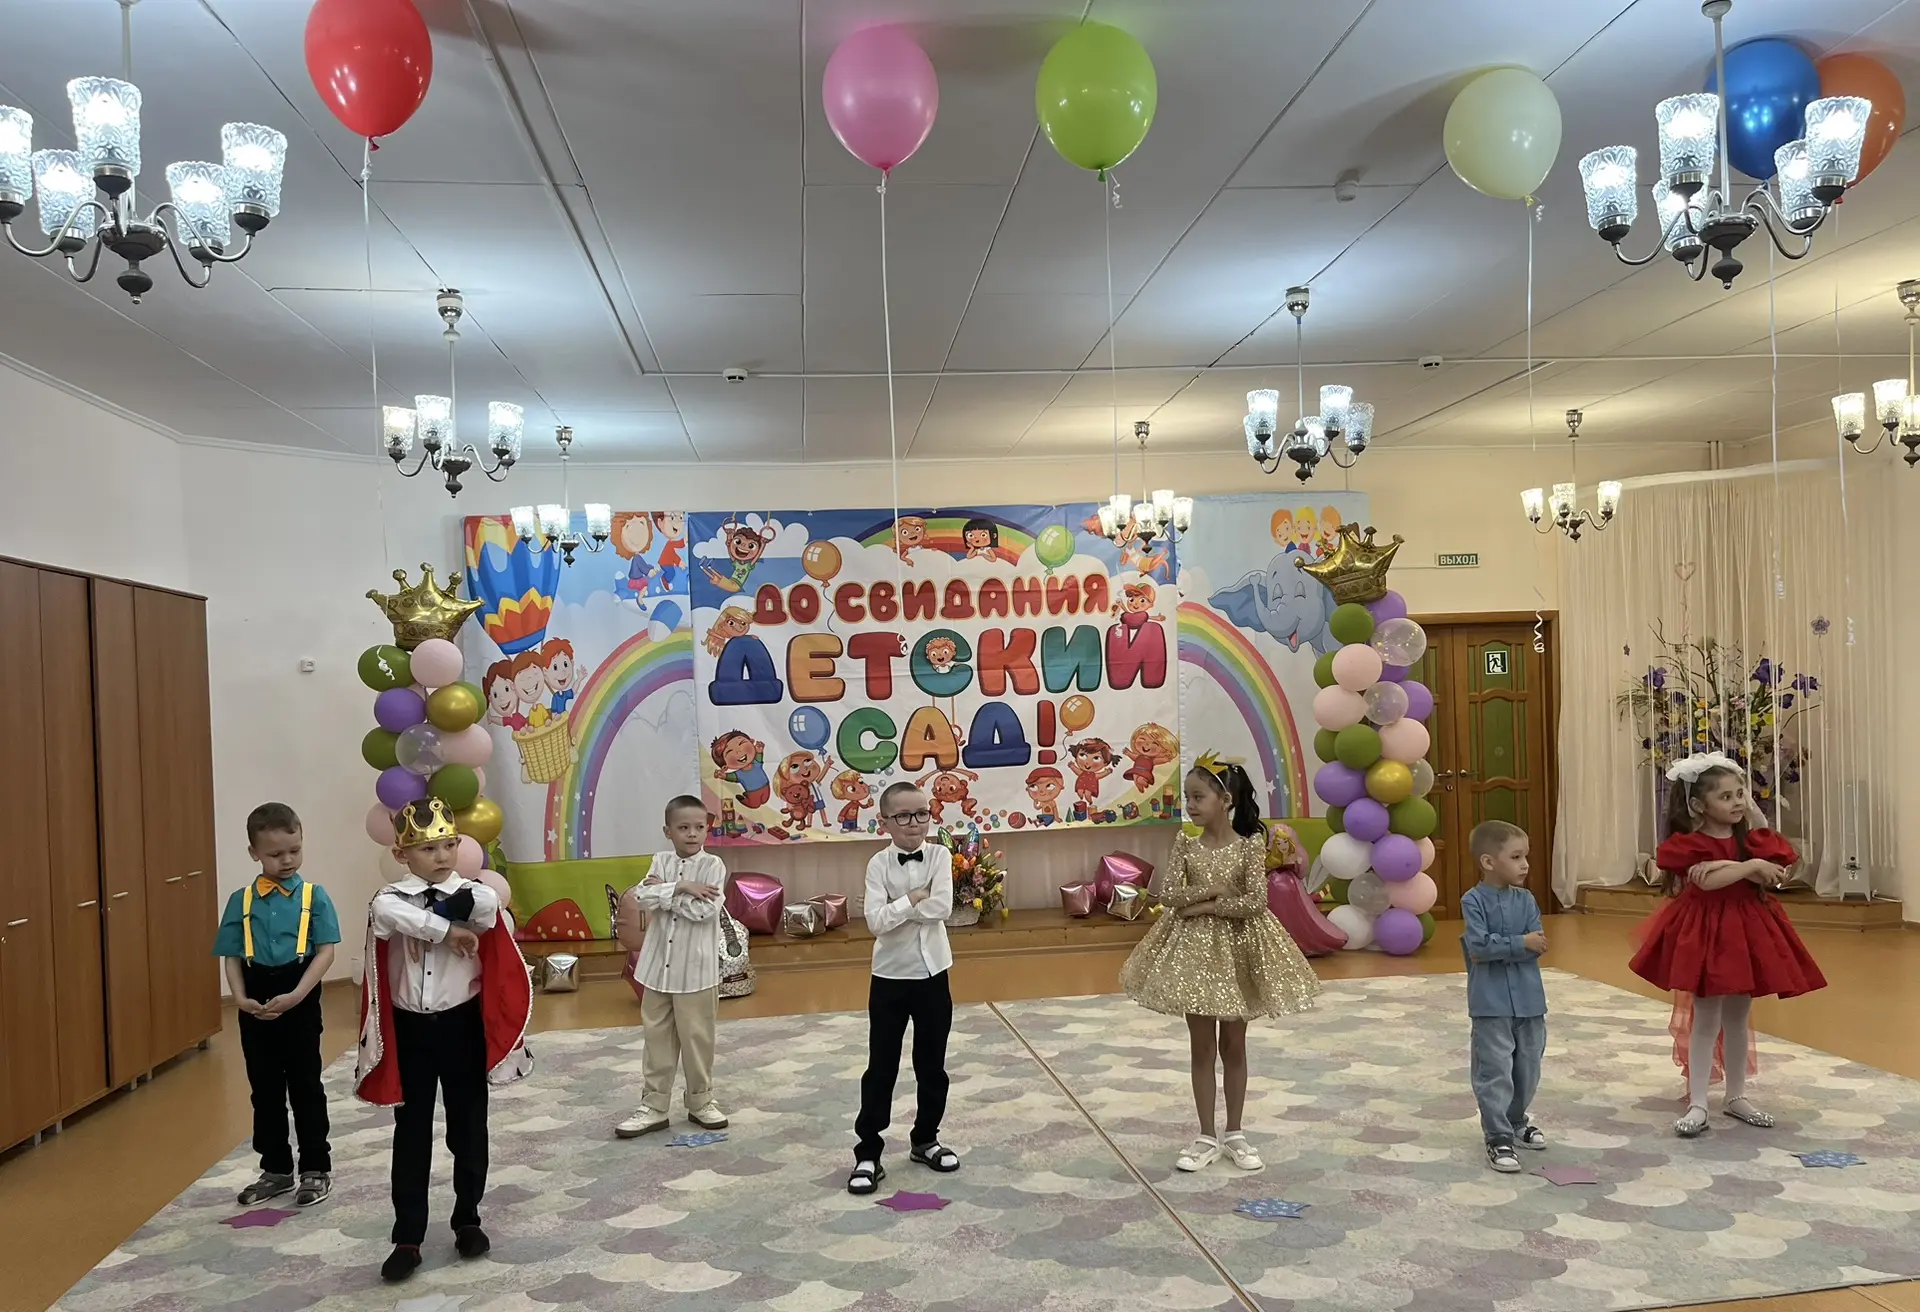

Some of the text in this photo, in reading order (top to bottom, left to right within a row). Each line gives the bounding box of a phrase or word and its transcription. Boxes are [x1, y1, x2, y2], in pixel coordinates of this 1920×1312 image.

[1440, 555, 1476, 565] ВЫХОД
[752, 573, 1110, 626] ДО СВИДАНИЯ
[708, 612, 1168, 706] ДЕТСКИЙ
[836, 700, 1057, 774] САД!
